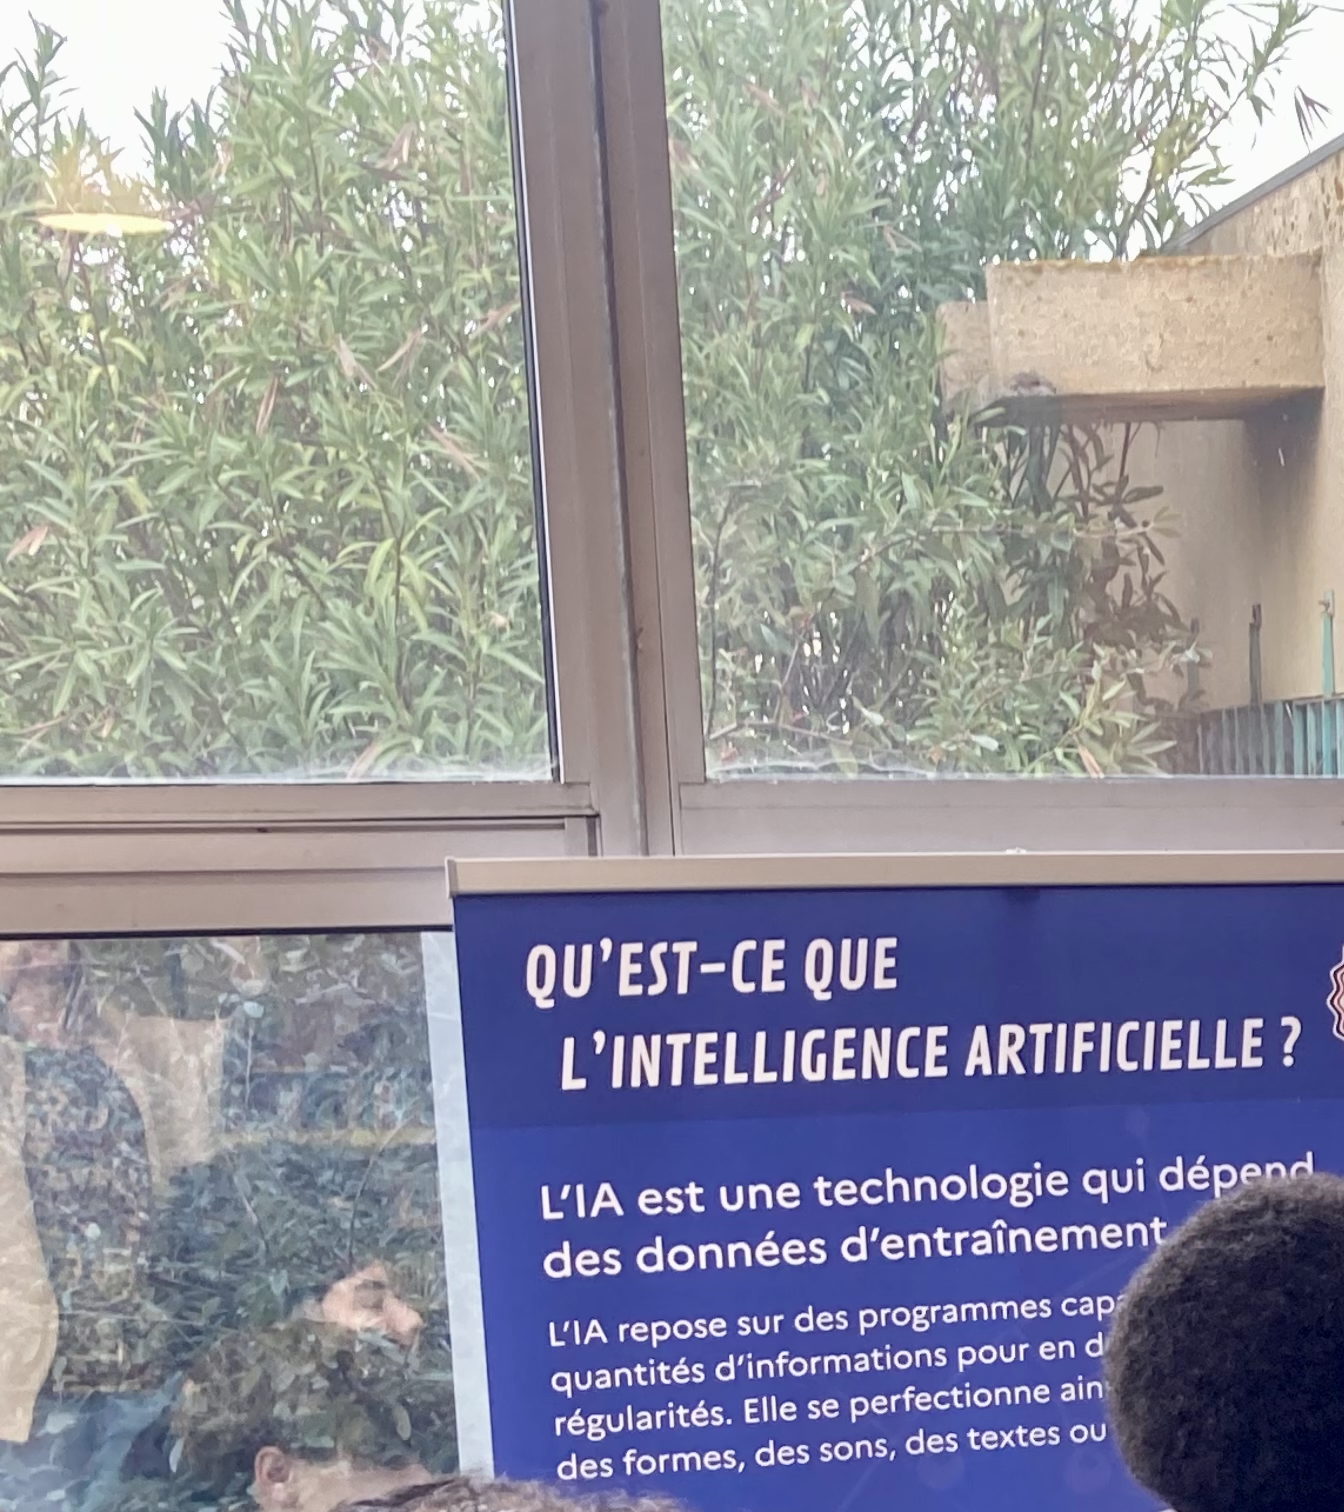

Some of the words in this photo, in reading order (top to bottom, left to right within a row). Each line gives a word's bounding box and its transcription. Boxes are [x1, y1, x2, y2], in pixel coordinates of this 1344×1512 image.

[527, 938, 785, 1008] QU'EST-CE
[805, 938, 897, 1000] QUE
[562, 1026, 948, 1090] L'INTELLIGENCE
[965, 1019, 1263, 1076] ARTIFICIELLE
[1281, 1016, 1301, 1066] ?
[542, 1183, 624, 1220] L'IA
[638, 1182, 705, 1215] est
[720, 1183, 800, 1211] une
[814, 1162, 1068, 1207] technologie
[1083, 1158, 1144, 1204] qui
[1159, 1151, 1314, 1195] dépend
[544, 1241, 621, 1278] des
[636, 1231, 826, 1273] données
[841, 1217, 1167, 1263] d'entraînement
[550, 1320, 608, 1346] L'IA
[619, 1318, 727, 1348] repose
[738, 1315, 784, 1335] sur
[795, 1305, 848, 1332] des
[859, 1299, 1051, 1335] programmes
[551, 1357, 705, 1398] quantités
[715, 1344, 947, 1381] d'informations
[958, 1343, 1029, 1372] pour
[1039, 1341, 1075, 1360] en
[555, 1400, 732, 1441] régularités.
[744, 1396, 796, 1423] Elle
[808, 1399, 839, 1419] se
[850, 1382, 1049, 1423] perfectionne
[557, 1453, 613, 1480] des
[623, 1449, 744, 1475] formes,
[755, 1440, 809, 1466] des
[820, 1439, 895, 1462] sons,
[906, 1429, 958, 1454] des
[967, 1426, 1060, 1450] textes
